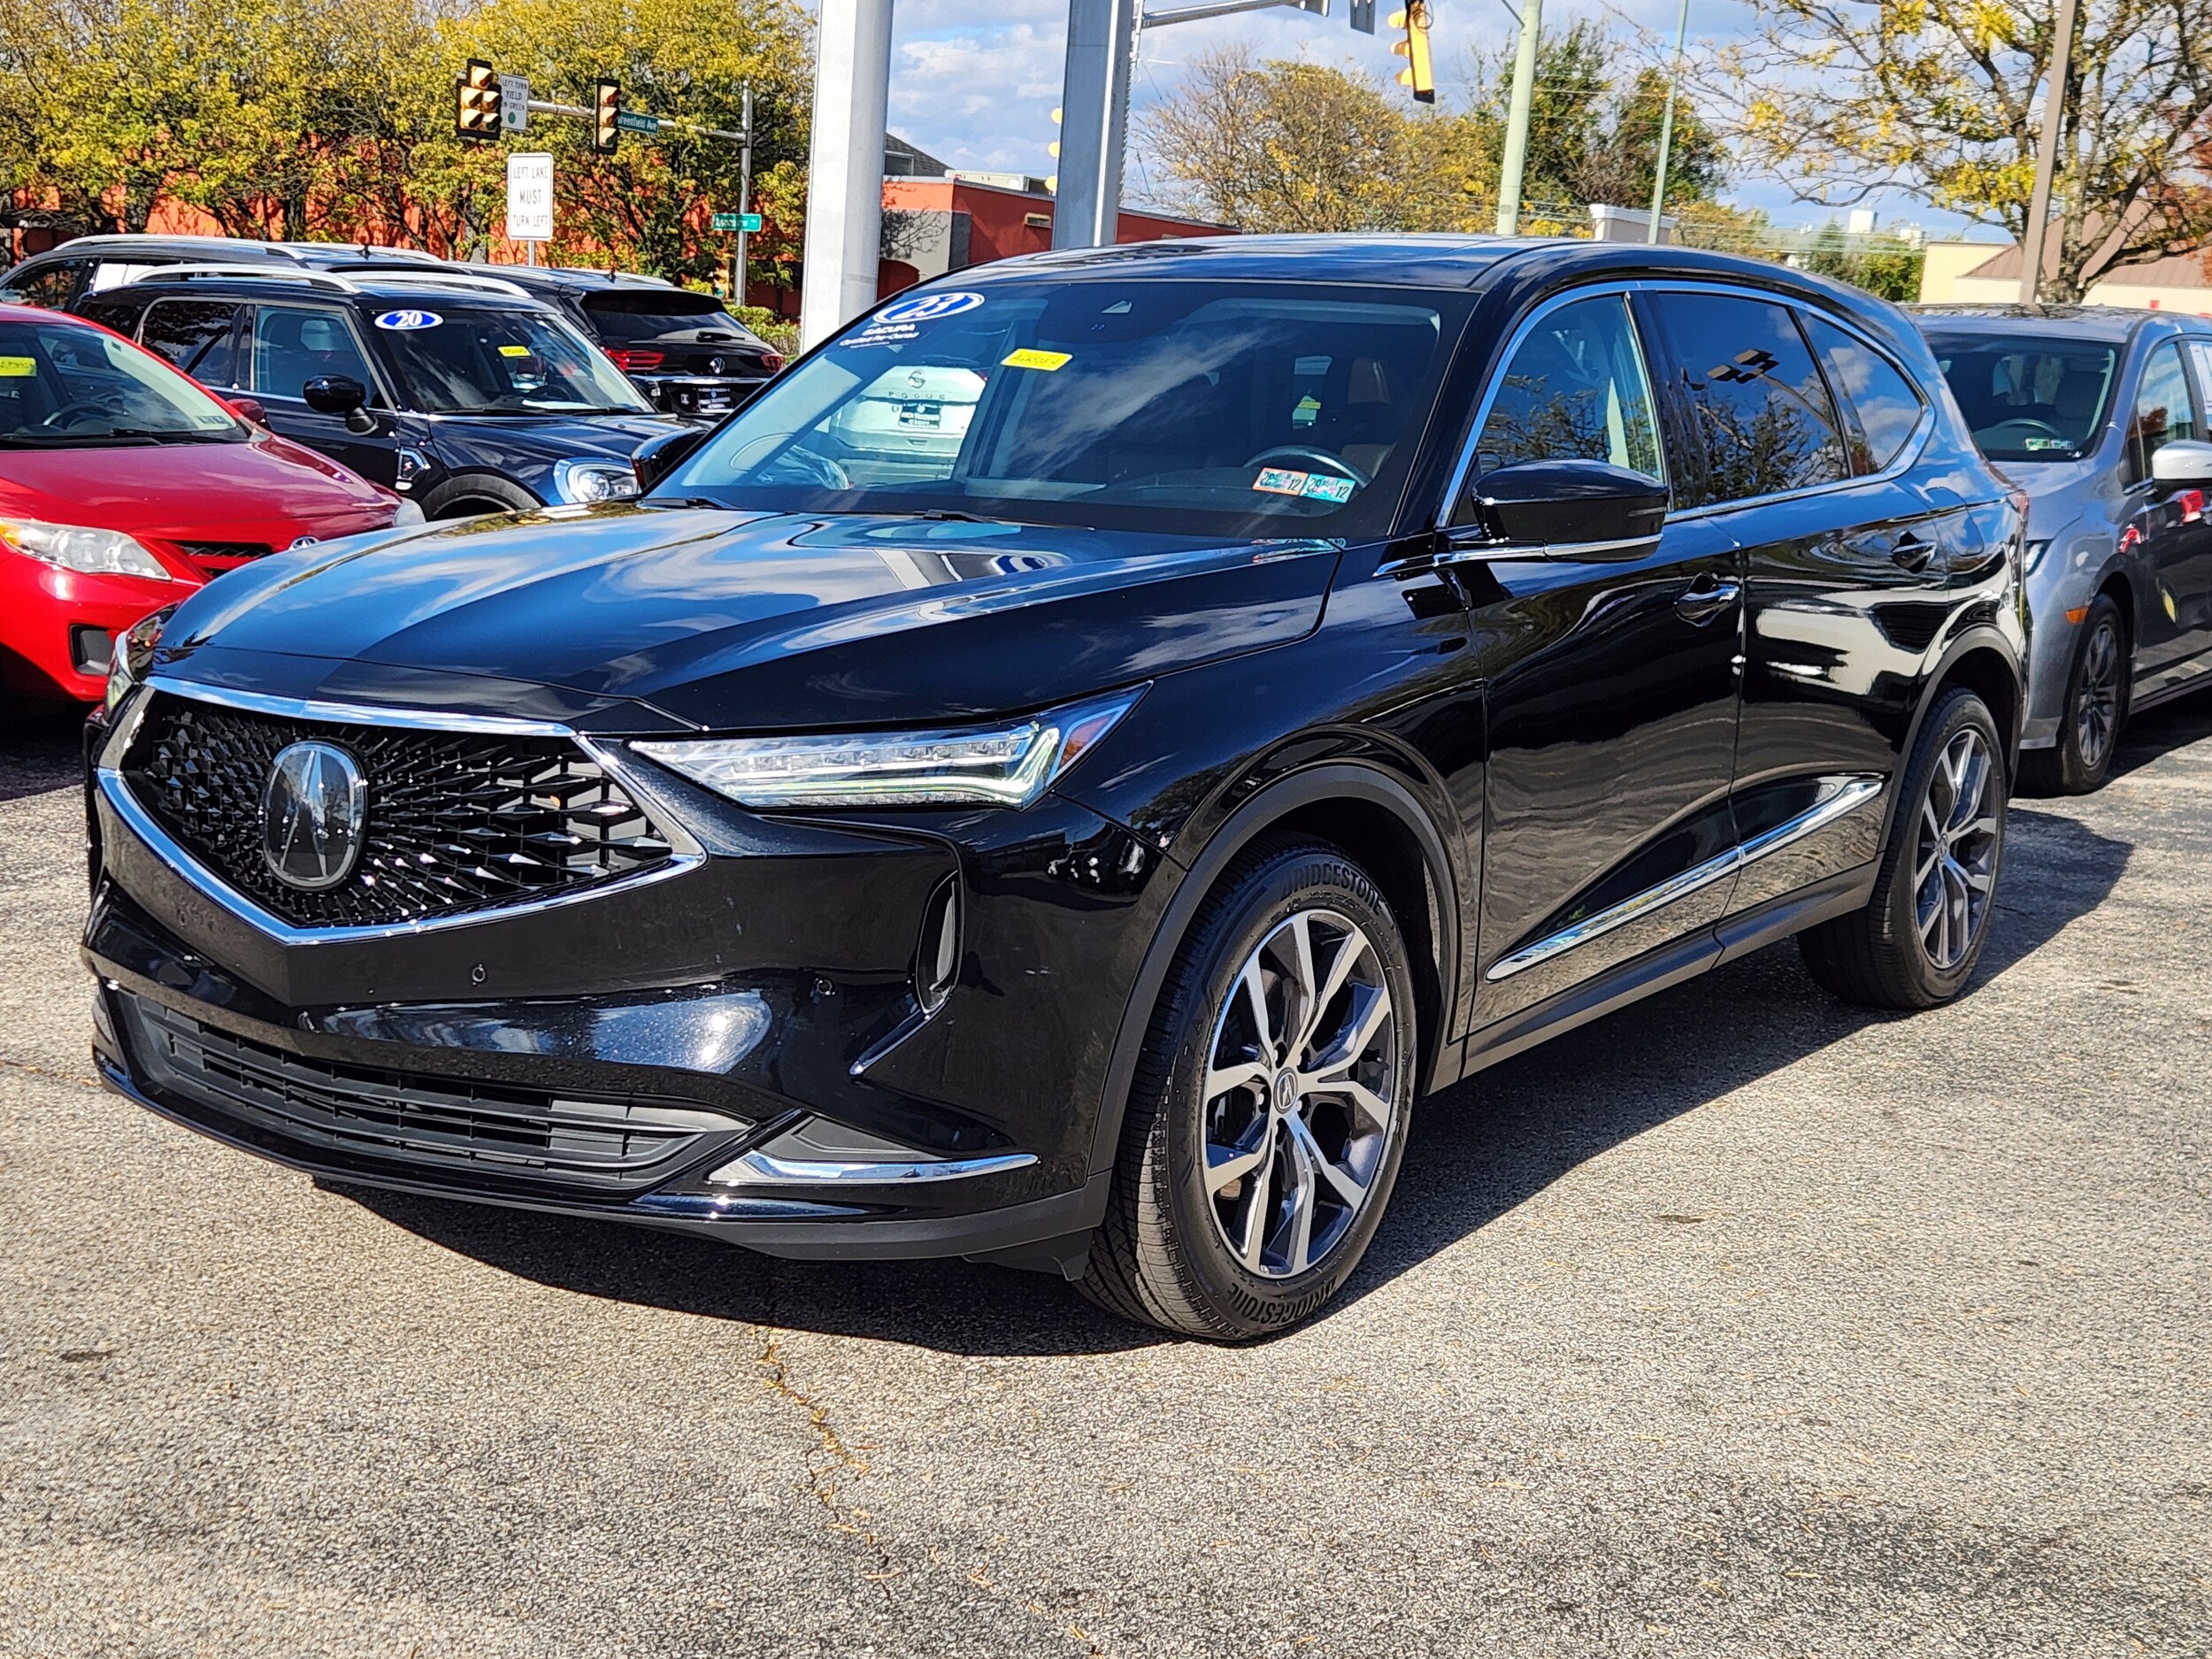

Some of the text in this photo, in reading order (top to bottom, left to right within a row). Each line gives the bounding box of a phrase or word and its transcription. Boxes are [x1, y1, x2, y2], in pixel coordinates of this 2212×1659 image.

[502, 78, 527, 90] LEFT TURN
[506, 89, 523, 101] YIELD
[510, 102, 526, 111] GREEN
[646, 119, 657, 131] Ave
[513, 166, 549, 180] LEFT LANE
[519, 188, 542, 205] MUST
[512, 214, 549, 227] TURN LEFT
[889, 293, 966, 320] 23
[394, 311, 424, 327] 20
[1287, 478, 1302, 491] 12
[1335, 485, 1351, 499] 12
[1279, 862, 1383, 917] BRIDGESTONE
[1226, 1274, 1339, 1325] BRIDGESTONE
